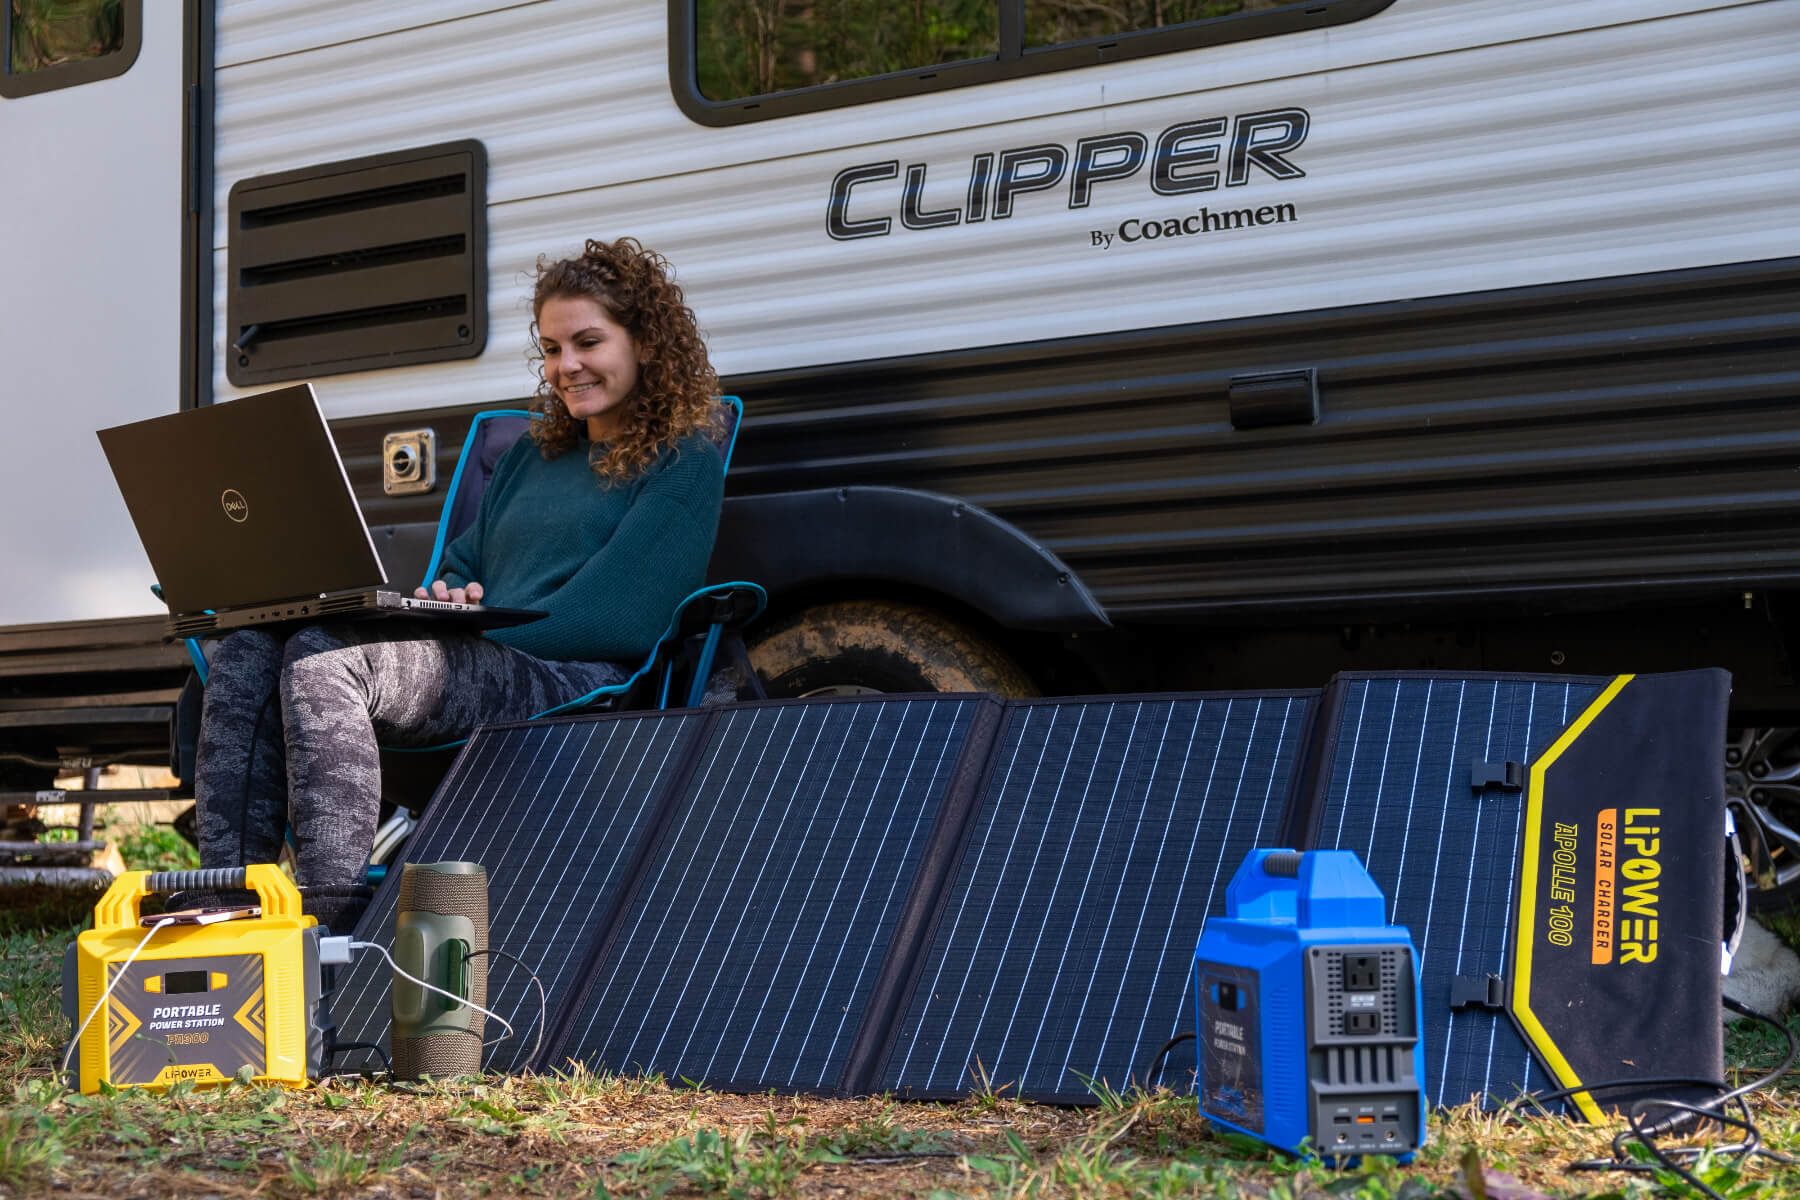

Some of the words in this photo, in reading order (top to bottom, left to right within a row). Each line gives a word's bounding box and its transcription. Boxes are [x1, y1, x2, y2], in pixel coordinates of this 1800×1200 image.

[826, 107, 1310, 241] CLIPPER
[1091, 230, 1114, 249] By
[1118, 202, 1297, 243] Coachmen
[225, 501, 246, 511] DELL
[1551, 822, 1578, 903] APOLLE
[1600, 822, 1614, 869] SOLAR
[1548, 905, 1574, 947] 100
[1597, 879, 1612, 949] CHARGER
[149, 1020, 183, 1031] POWER
[184, 1018, 225, 1029] STATION
[153, 1004, 221, 1018] PORTABLE
[1215, 1020, 1243, 1040] PORTABLE
